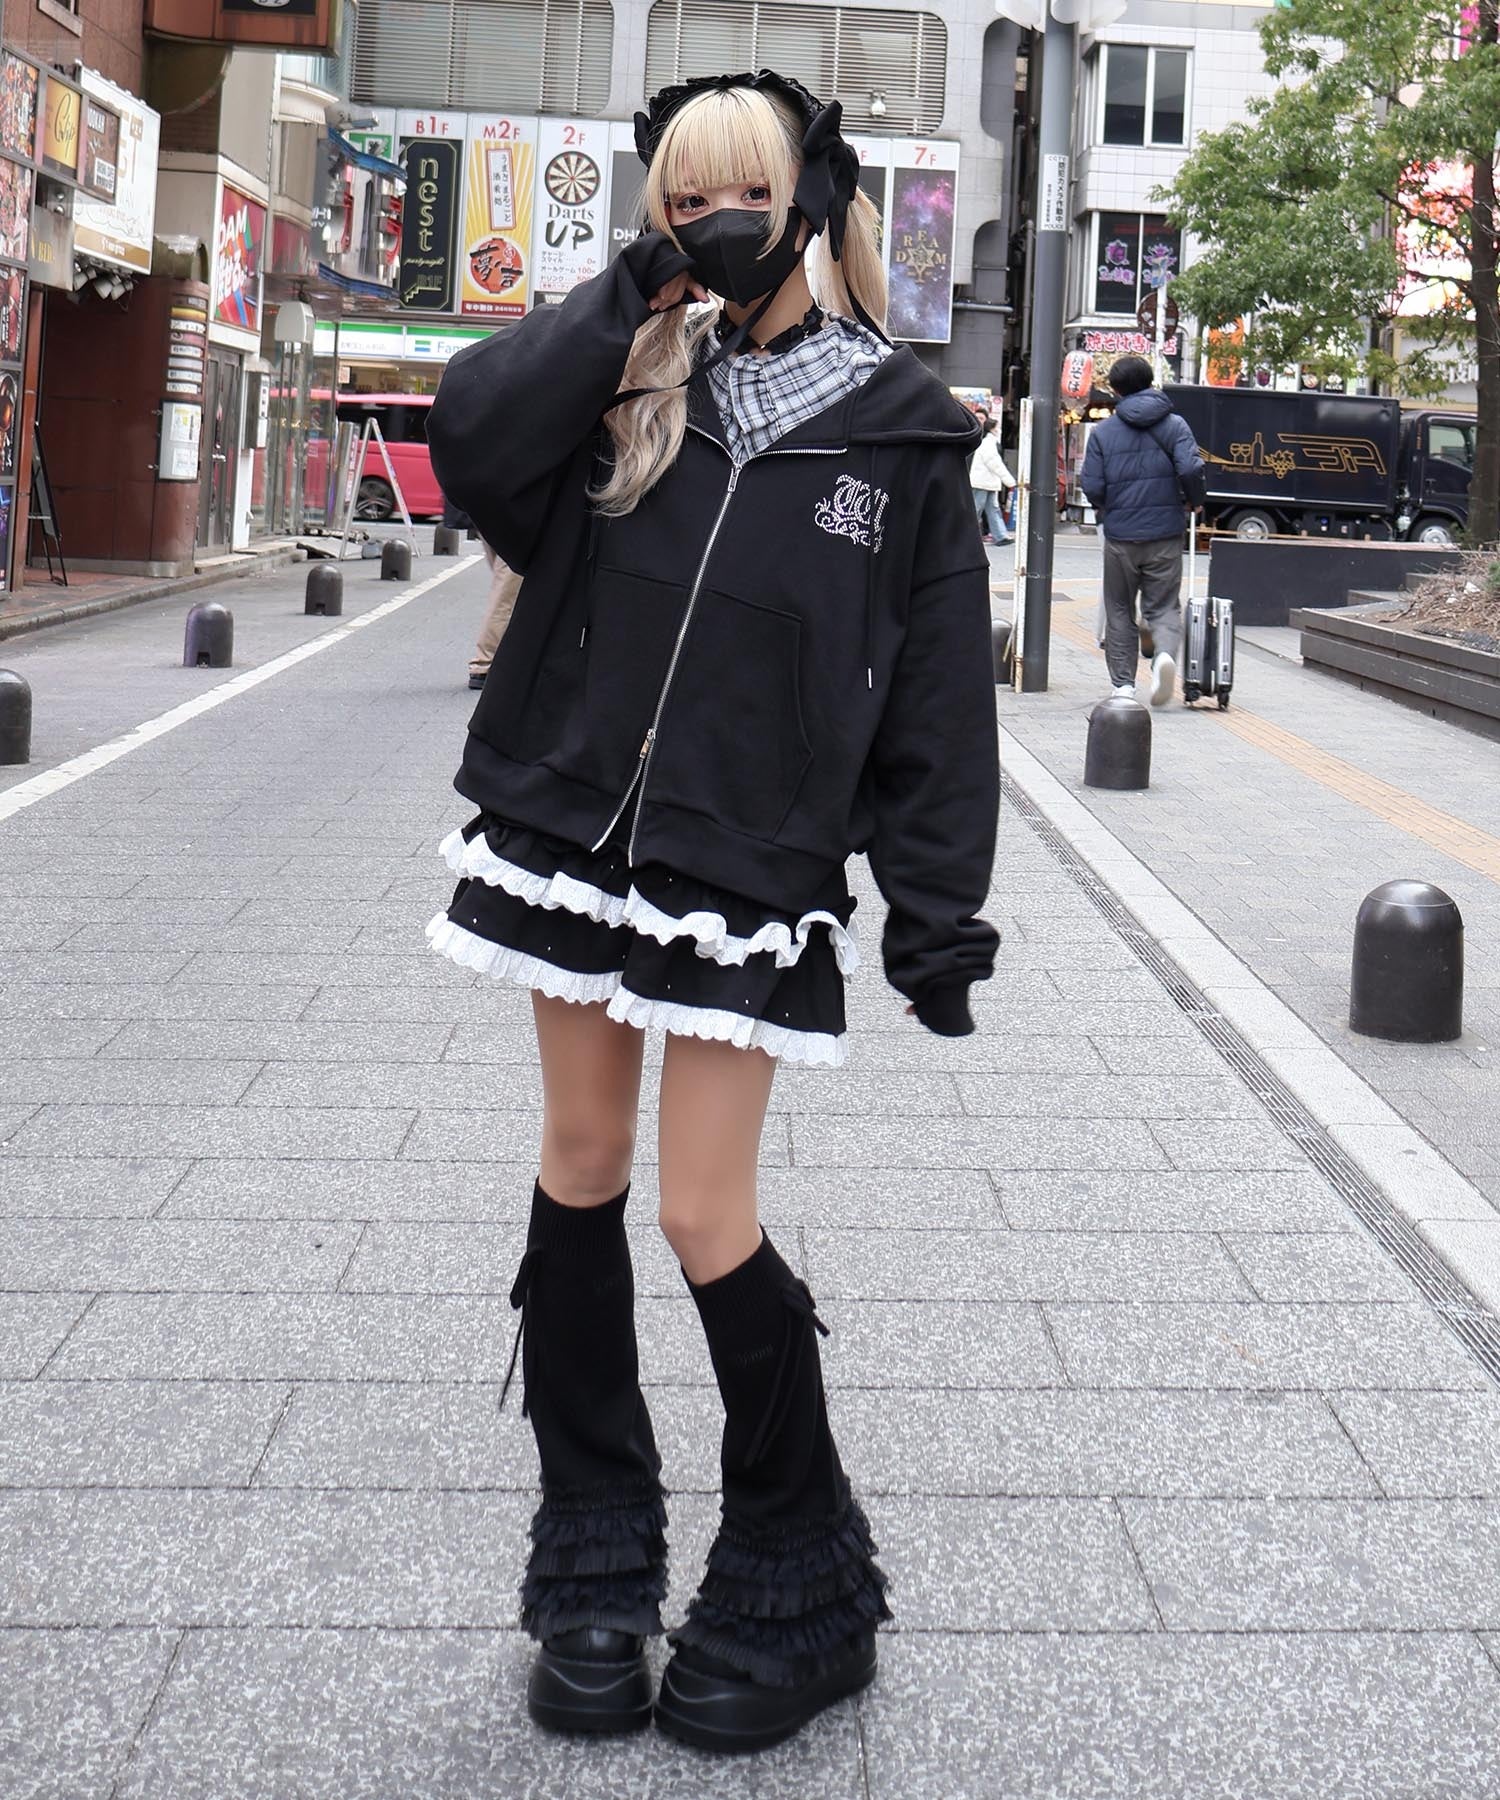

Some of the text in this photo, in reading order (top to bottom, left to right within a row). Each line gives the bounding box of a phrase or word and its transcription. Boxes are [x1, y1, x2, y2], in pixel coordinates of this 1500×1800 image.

[416, 116, 449, 136] B1F
[483, 120, 521, 139] M2F
[562, 126, 586, 144] 2F
[914, 147, 937, 165] 7F
[418, 158, 439, 252] nest
[548, 203, 595, 220] Darts
[545, 220, 595, 251] UP
